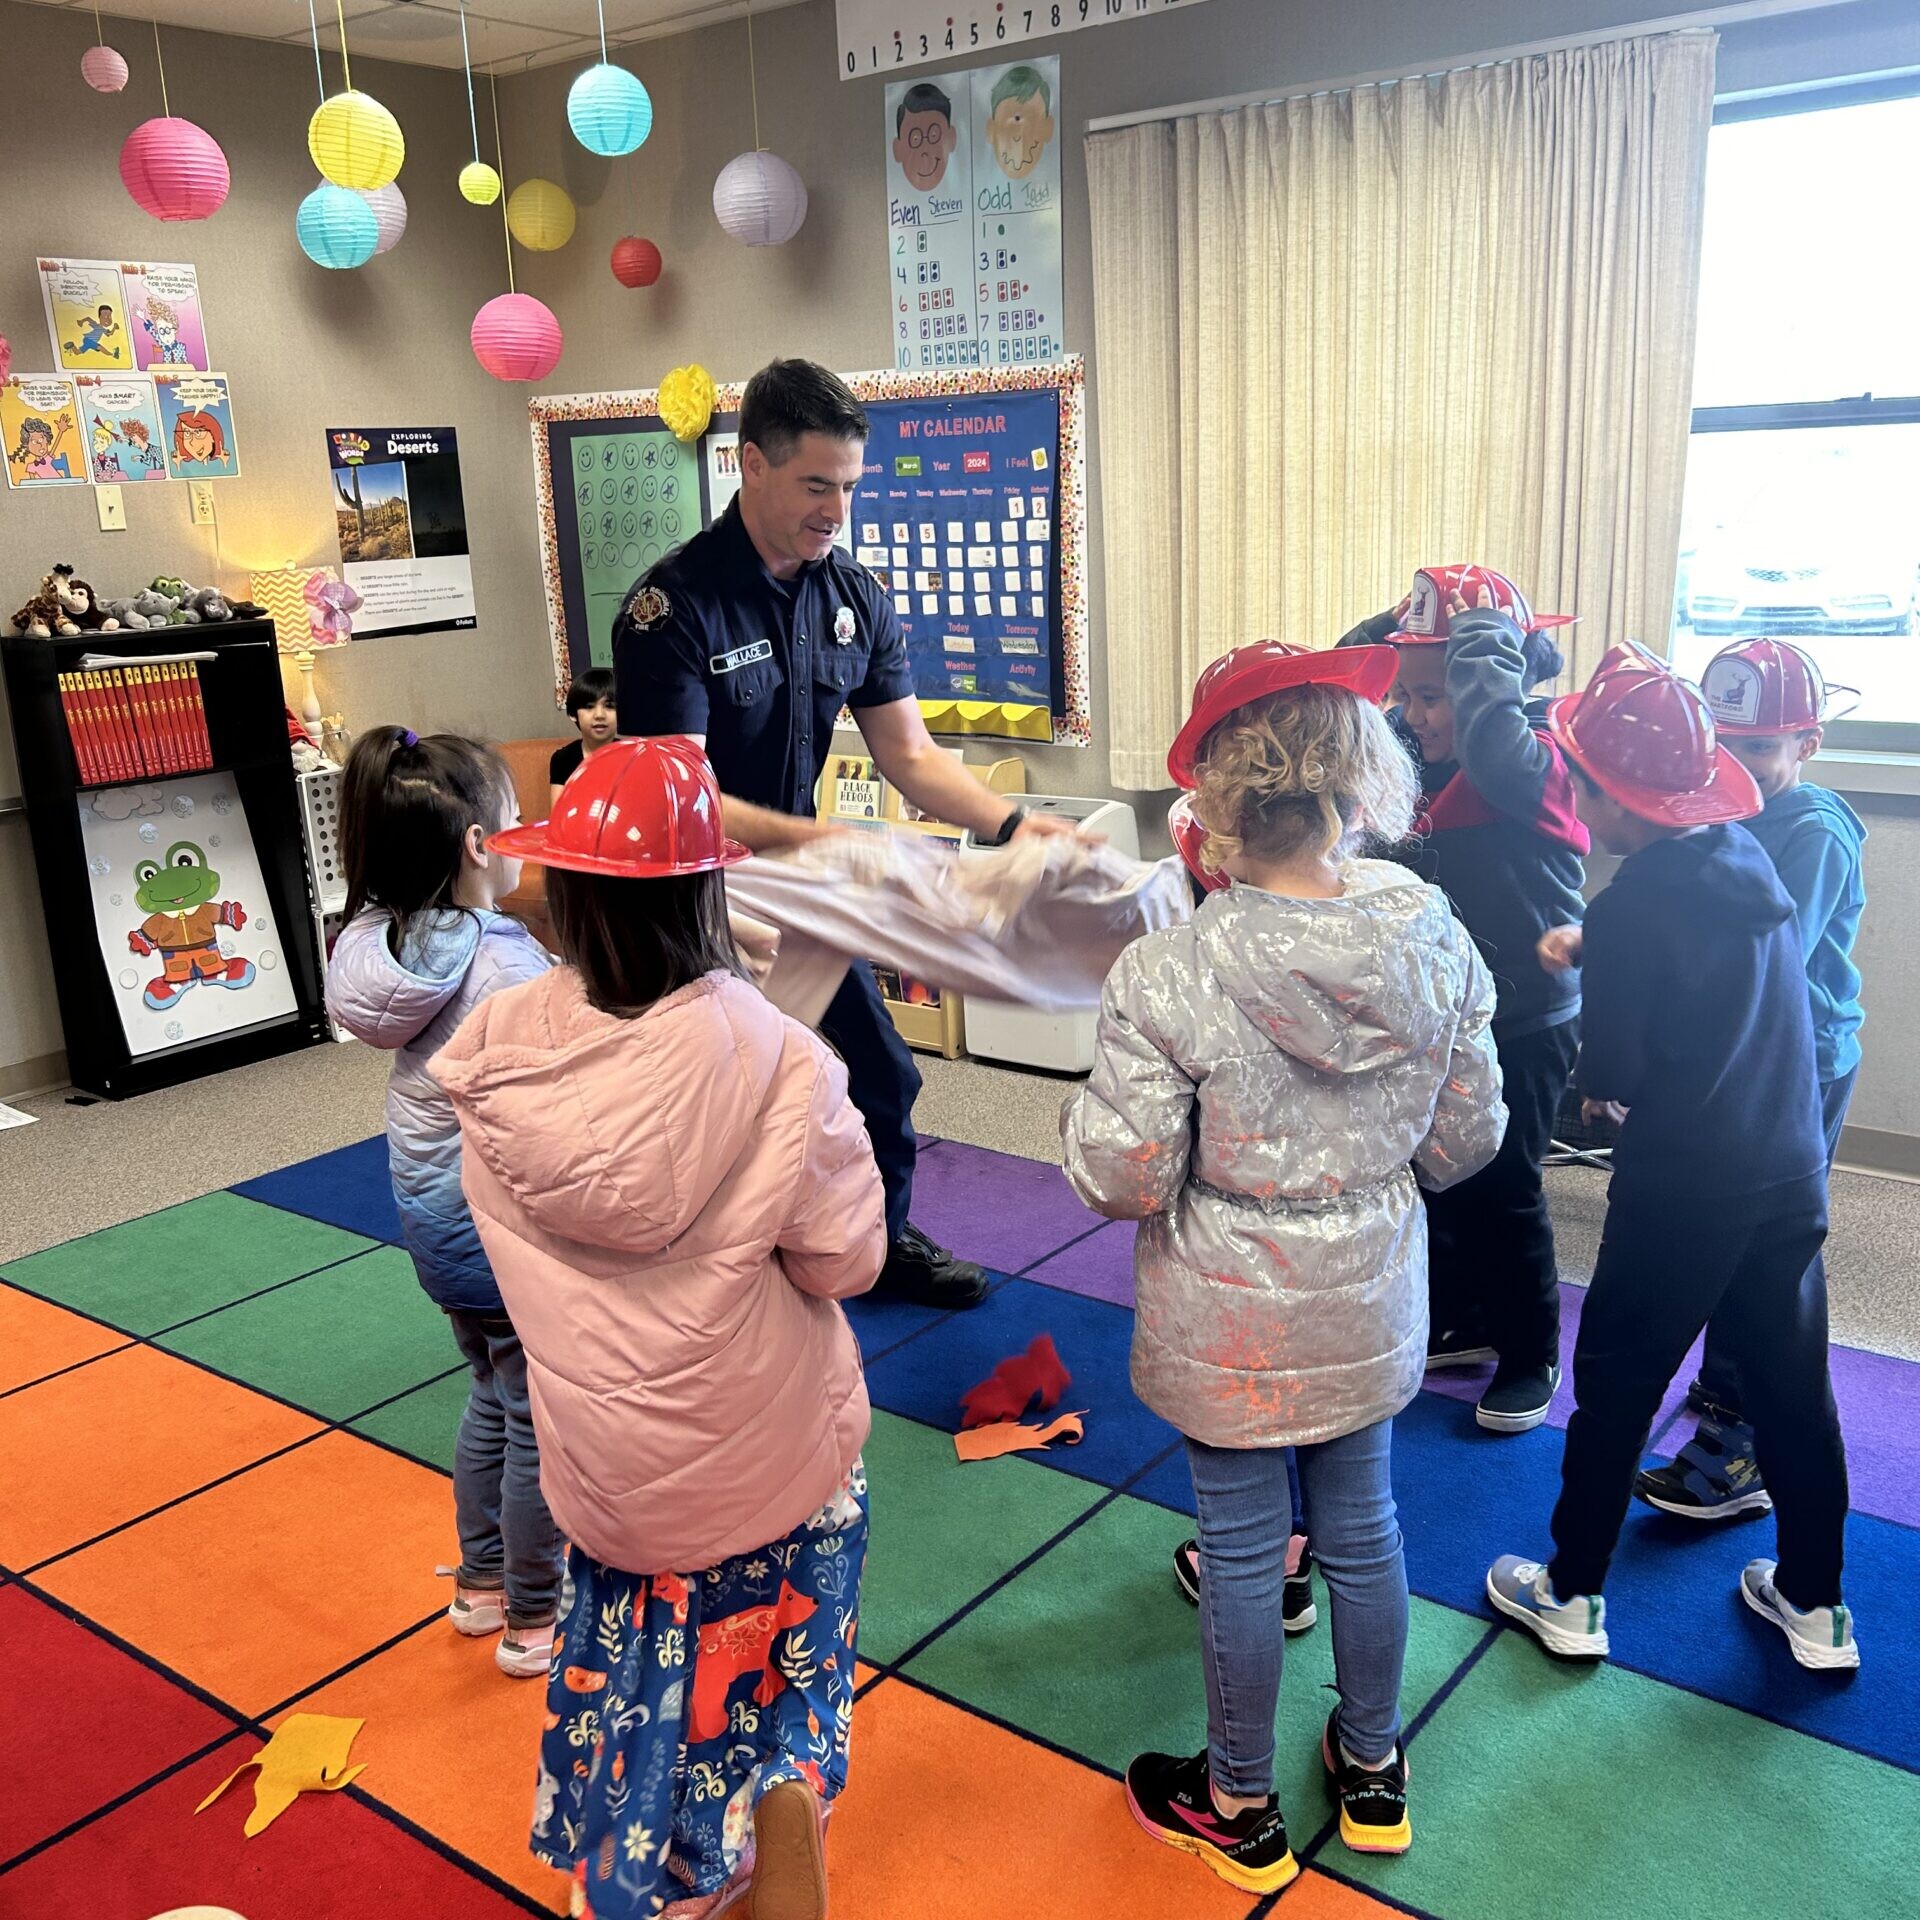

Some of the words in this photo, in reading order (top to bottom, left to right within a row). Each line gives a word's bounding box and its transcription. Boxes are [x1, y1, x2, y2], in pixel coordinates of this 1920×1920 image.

[847, 52, 855, 72] 0
[872, 46, 877, 67] 1
[895, 41, 904, 62] 2
[920, 34, 928, 56] 3
[945, 28, 953, 50] 4
[970, 24, 979, 45] 5
[996, 17, 1006, 39] 6
[1024, 11, 1032, 32] 7
[1052, 5, 1061, 26] 8
[1079, 0, 1088, 21] 9
[978, 182, 1012, 212] Odd
[891, 198, 920, 226] Even
[928, 196, 962, 216] Steven
[982, 222, 986, 238] 1
[897, 235, 906, 254] 2
[978, 252, 990, 270] 3
[897, 266, 906, 284] 4
[978, 283, 990, 302] 5
[900, 296, 908, 312] 6
[900, 321, 908, 339] 8
[980, 314, 989, 332] 7
[898, 347, 911, 369] 10
[980, 340, 990, 364] 9
[900, 420, 920, 438] MY
[924, 415, 1006, 438] CALENDAR
[387, 440, 439, 455] Deserts
[932, 460, 950, 473] Year
[967, 458, 987, 468] 2024
[1011, 457, 1028, 468] Feel
[1014, 503, 1019, 513] 1
[1036, 502, 1042, 513] 2
[868, 528, 875, 539] 3
[898, 528, 904, 539] 4
[924, 528, 931, 539] 5
[625, 587, 647, 614] VALLEY
[650, 586, 670, 616] REGIONAL
[947, 622, 969, 634] Today
[726, 646, 762, 668] WALLACE
[945, 660, 976, 671] Weather
[1009, 663, 1036, 676] Activity
[843, 781, 871, 793] BLACK
[840, 791, 874, 803] HEROES
[1177, 1792, 1192, 1804] FILA
[1359, 1790, 1375, 1799] FILA
[1379, 1790, 1395, 1800] FILA
[1240, 1840, 1257, 1852] FILA
[1259, 1828, 1275, 1842] FILA
